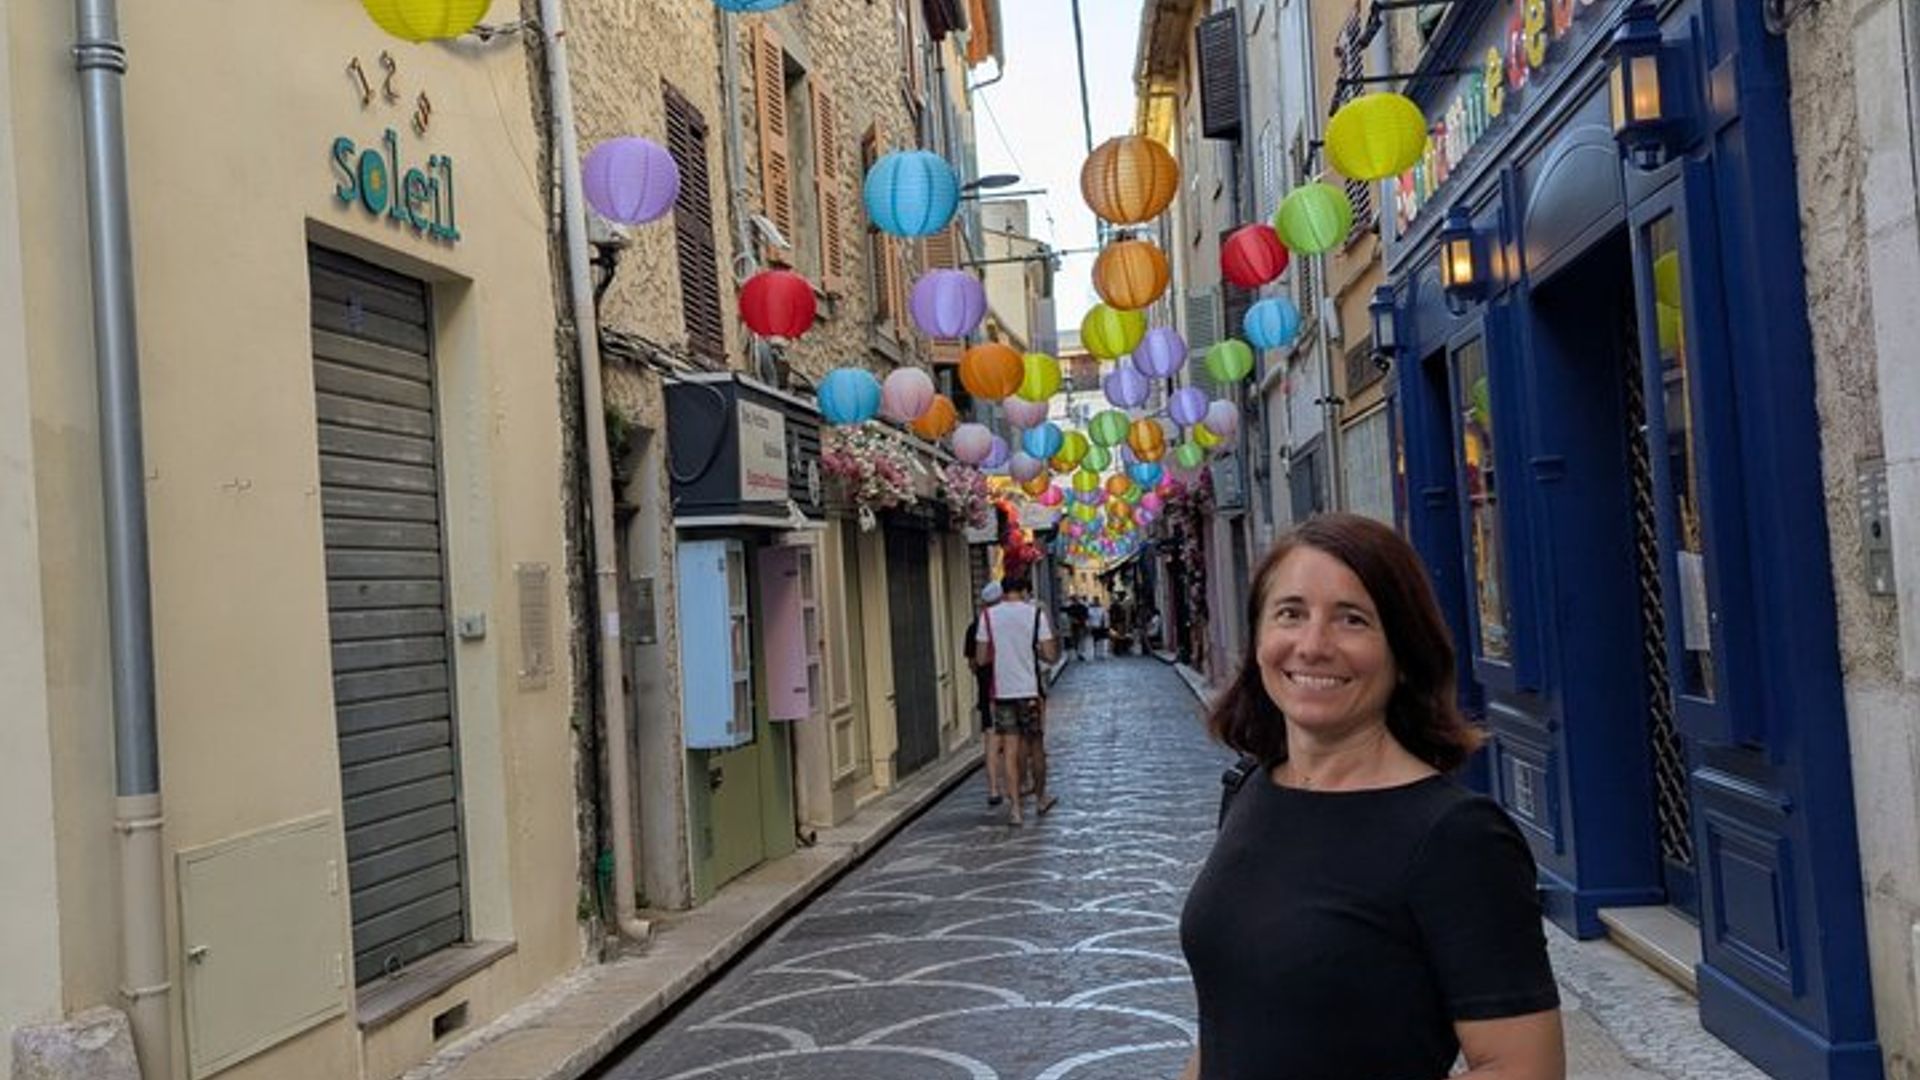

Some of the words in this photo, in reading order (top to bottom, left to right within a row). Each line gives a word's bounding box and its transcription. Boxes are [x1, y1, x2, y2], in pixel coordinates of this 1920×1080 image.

[347, 57, 374, 105] 1
[380, 51, 400, 99] 2
[333, 128, 461, 241] soleil
